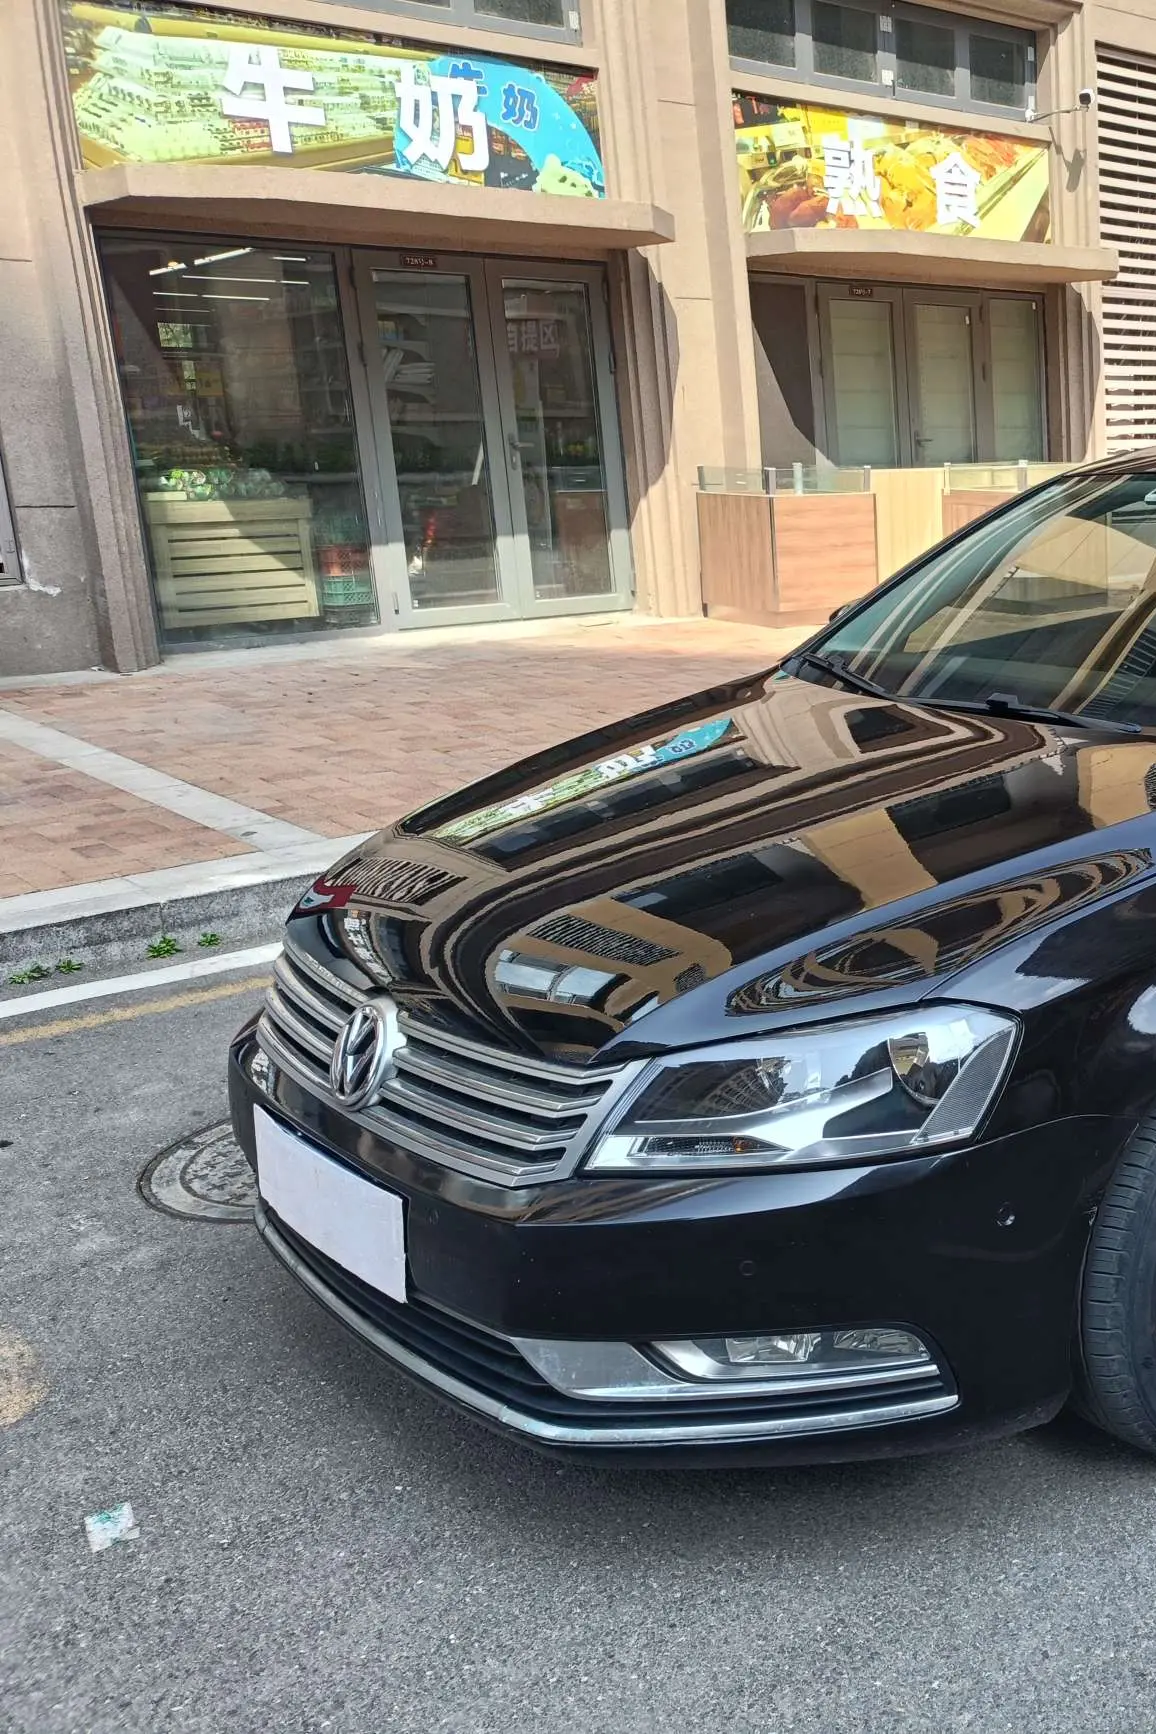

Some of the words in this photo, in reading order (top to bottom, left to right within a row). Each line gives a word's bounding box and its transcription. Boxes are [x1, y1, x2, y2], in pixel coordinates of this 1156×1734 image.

[220, 45, 491, 174] 牛奶
[822, 131, 982, 229] 熟食
[506, 319, 560, 356] 自提区
